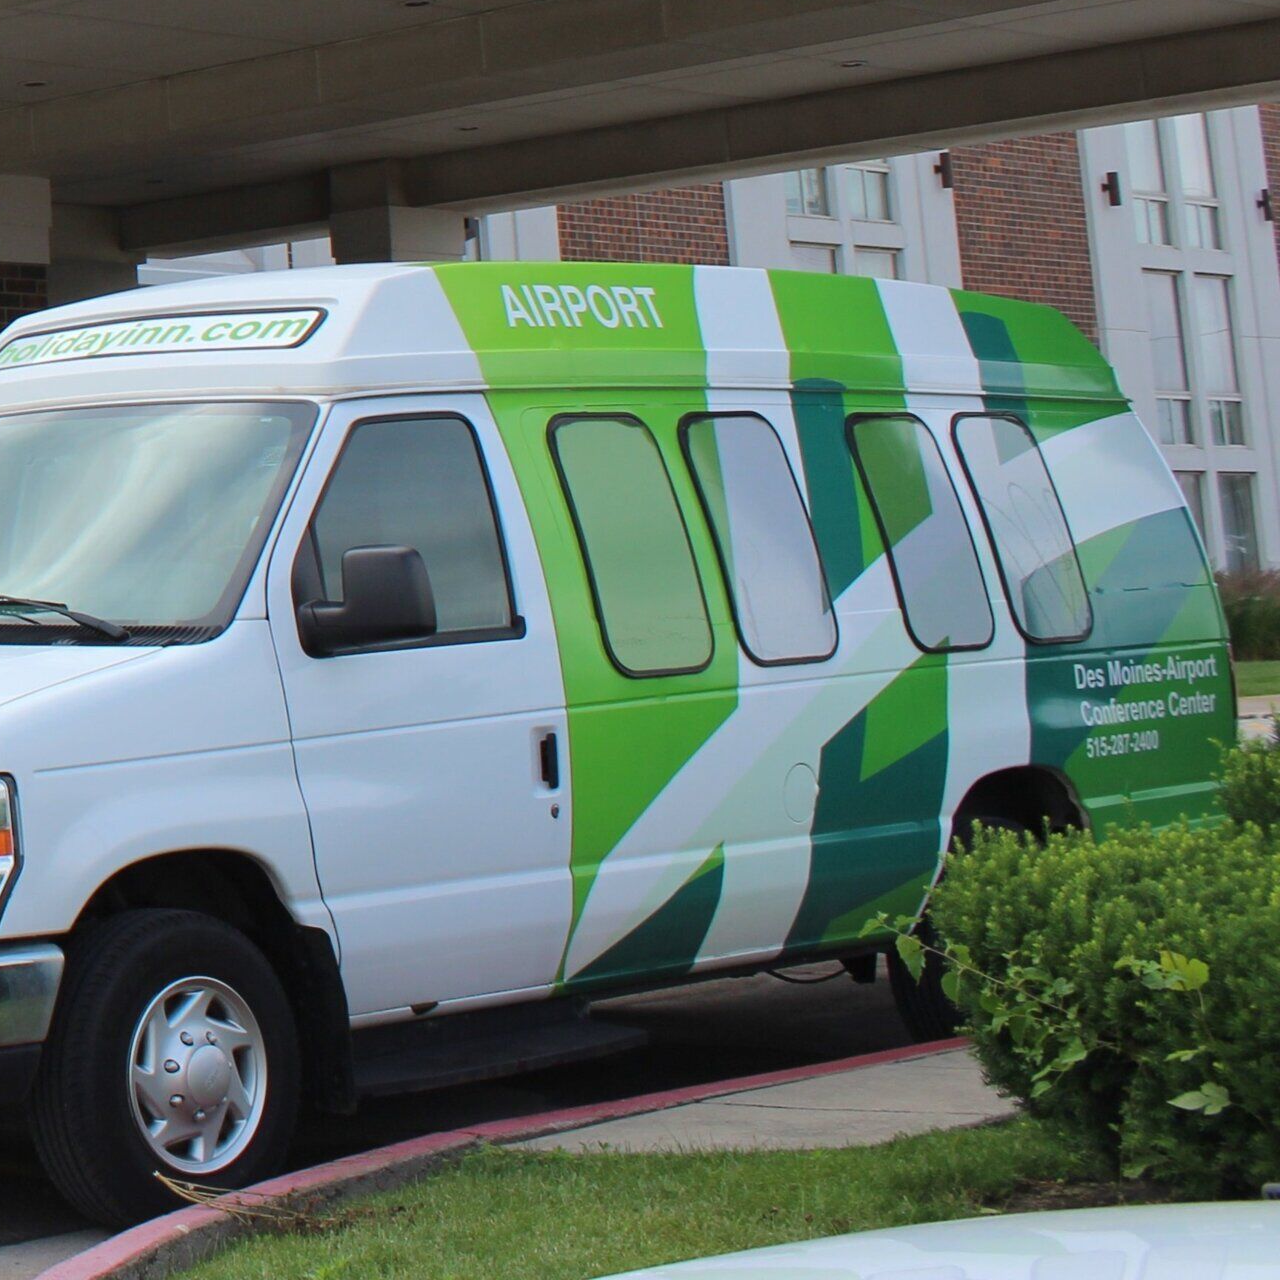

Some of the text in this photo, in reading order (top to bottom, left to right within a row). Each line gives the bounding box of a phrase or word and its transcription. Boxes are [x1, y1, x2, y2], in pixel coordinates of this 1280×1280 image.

[500, 284, 664, 329] AIRPORT
[1073, 654, 1218, 689] Des Moines-Airport
[1080, 691, 1216, 727] Conference Center
